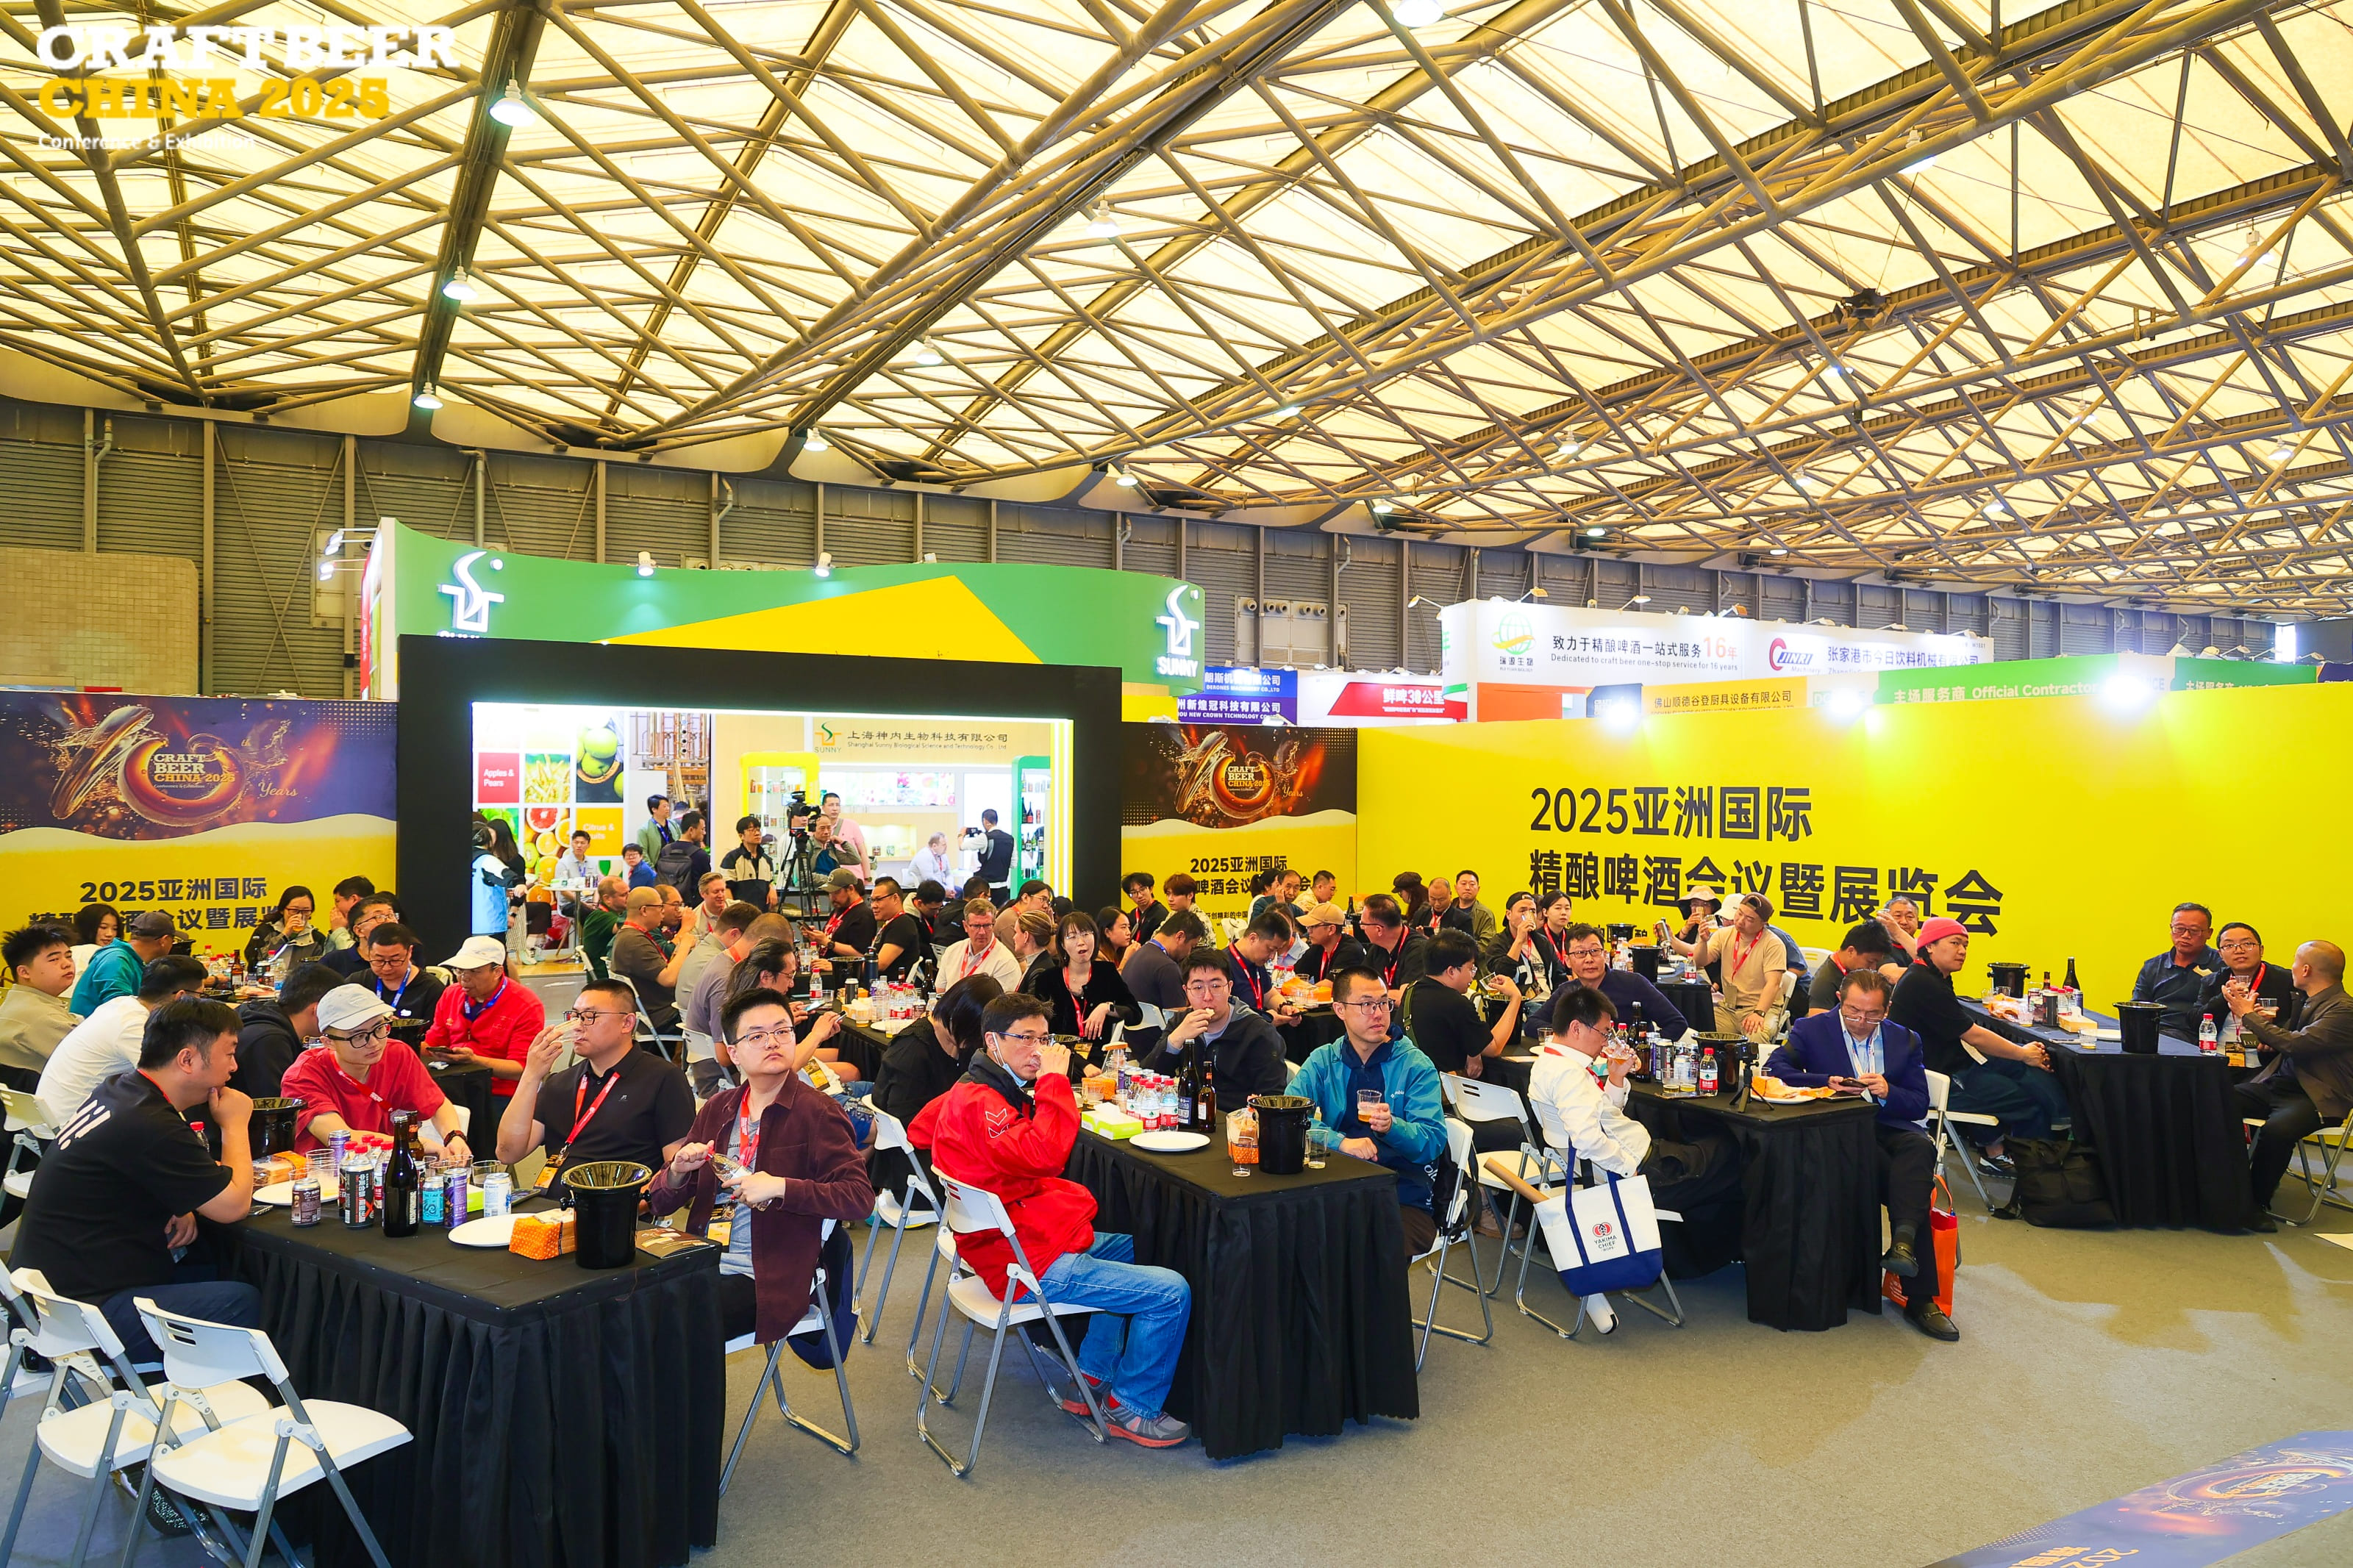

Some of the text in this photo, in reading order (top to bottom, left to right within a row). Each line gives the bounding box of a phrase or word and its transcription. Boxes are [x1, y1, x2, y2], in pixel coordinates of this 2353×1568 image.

[1551, 653, 1738, 672] Dedicated to craft beer one-stop service for 16 years
[1778, 653, 1813, 665] JINRI
[1157, 656, 1199, 678] SUNNY
[1205, 672, 1281, 686] 朗斯机公司
[1383, 687, 1445, 705] 鲜啤30公里
[1894, 681, 2098, 703] 主场服务商 Official Contractor
[154, 753, 206, 763] CRAFT
[154, 762, 206, 774] BEER
[483, 769, 515, 777] Apples &
[154, 773, 201, 782] CHINA
[483, 778, 504, 787] Pears
[1227, 773, 1255, 781] BEER
[258, 781, 298, 797] Years
[1282, 784, 1303, 797] Years
[1530, 786, 1812, 842] 2025亚洲国际
[1190, 856, 1288, 873] 2025亚洲国际
[79, 877, 267, 903] 2025亚洲国际
[1594, 1235, 1617, 1245] YAKIMA
[1598, 1241, 1615, 1249] CHIEF
